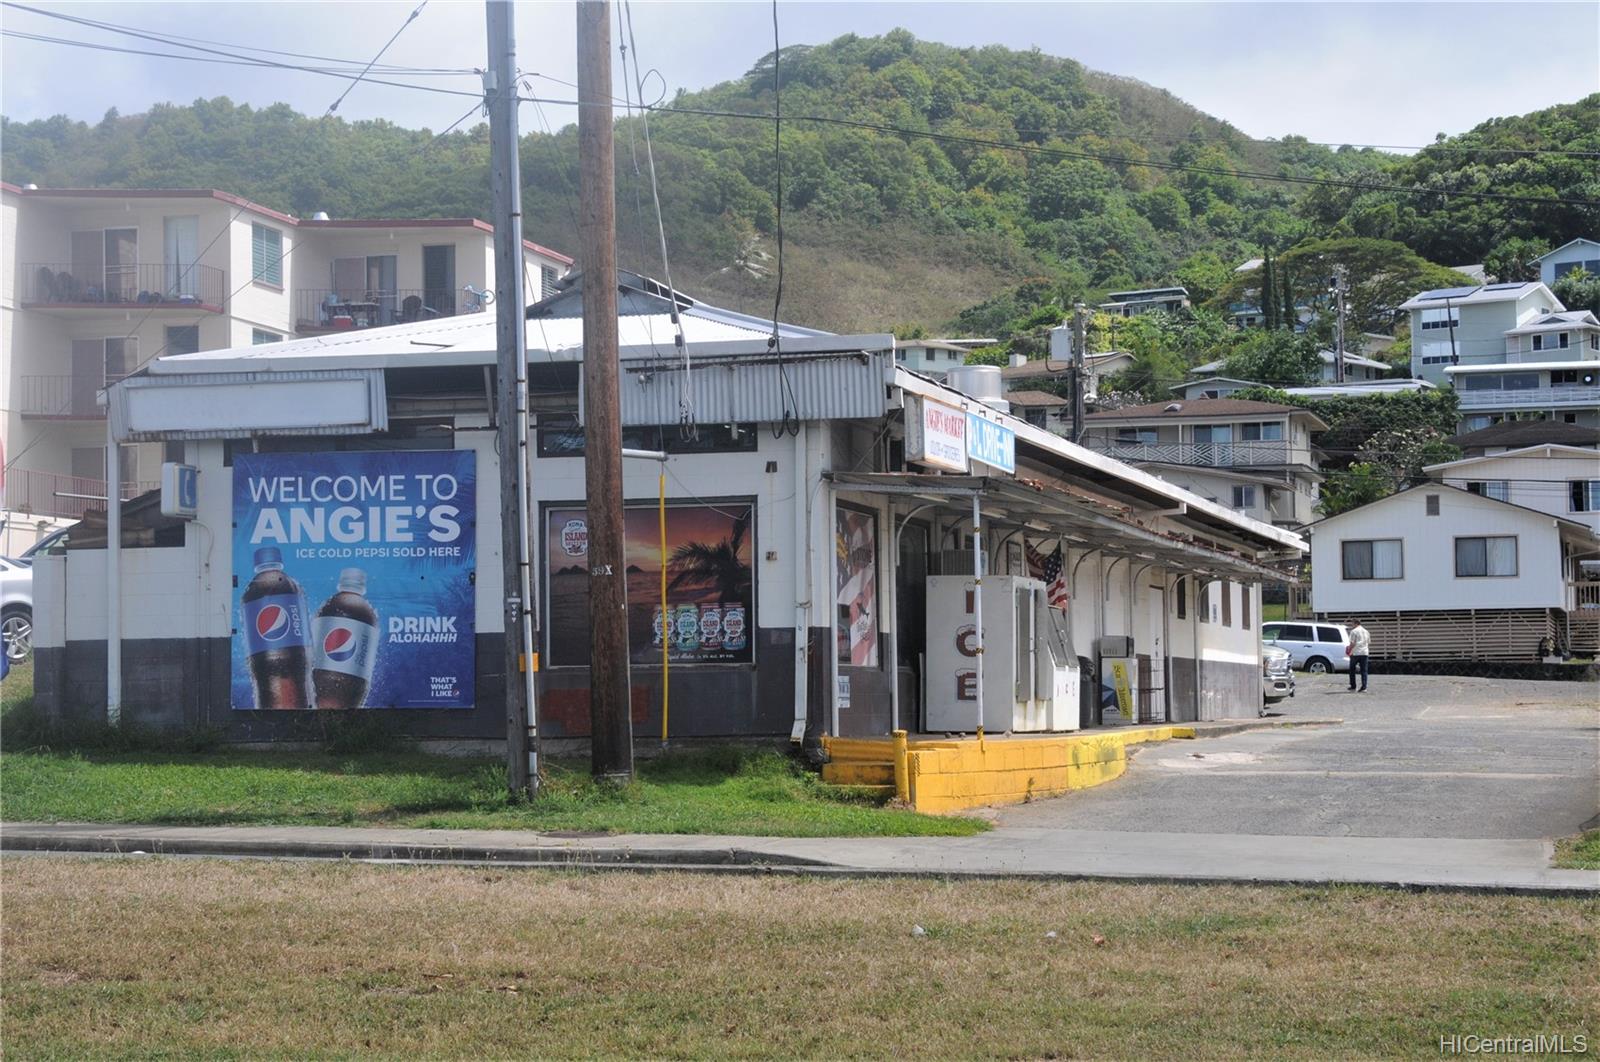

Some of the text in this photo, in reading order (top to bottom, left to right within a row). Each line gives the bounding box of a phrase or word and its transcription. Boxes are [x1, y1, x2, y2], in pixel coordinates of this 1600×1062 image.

[248, 473, 458, 502] WELCOME TO
[250, 505, 461, 543] ANGIE'S
[296, 546, 461, 558] ICE COLD PEPSI SOLD HERE
[290, 604, 302, 637] pepsi
[388, 616, 457, 633] DRINK
[388, 633, 458, 643] ALOHAHHH
[430, 676, 457, 684] THAT'S
